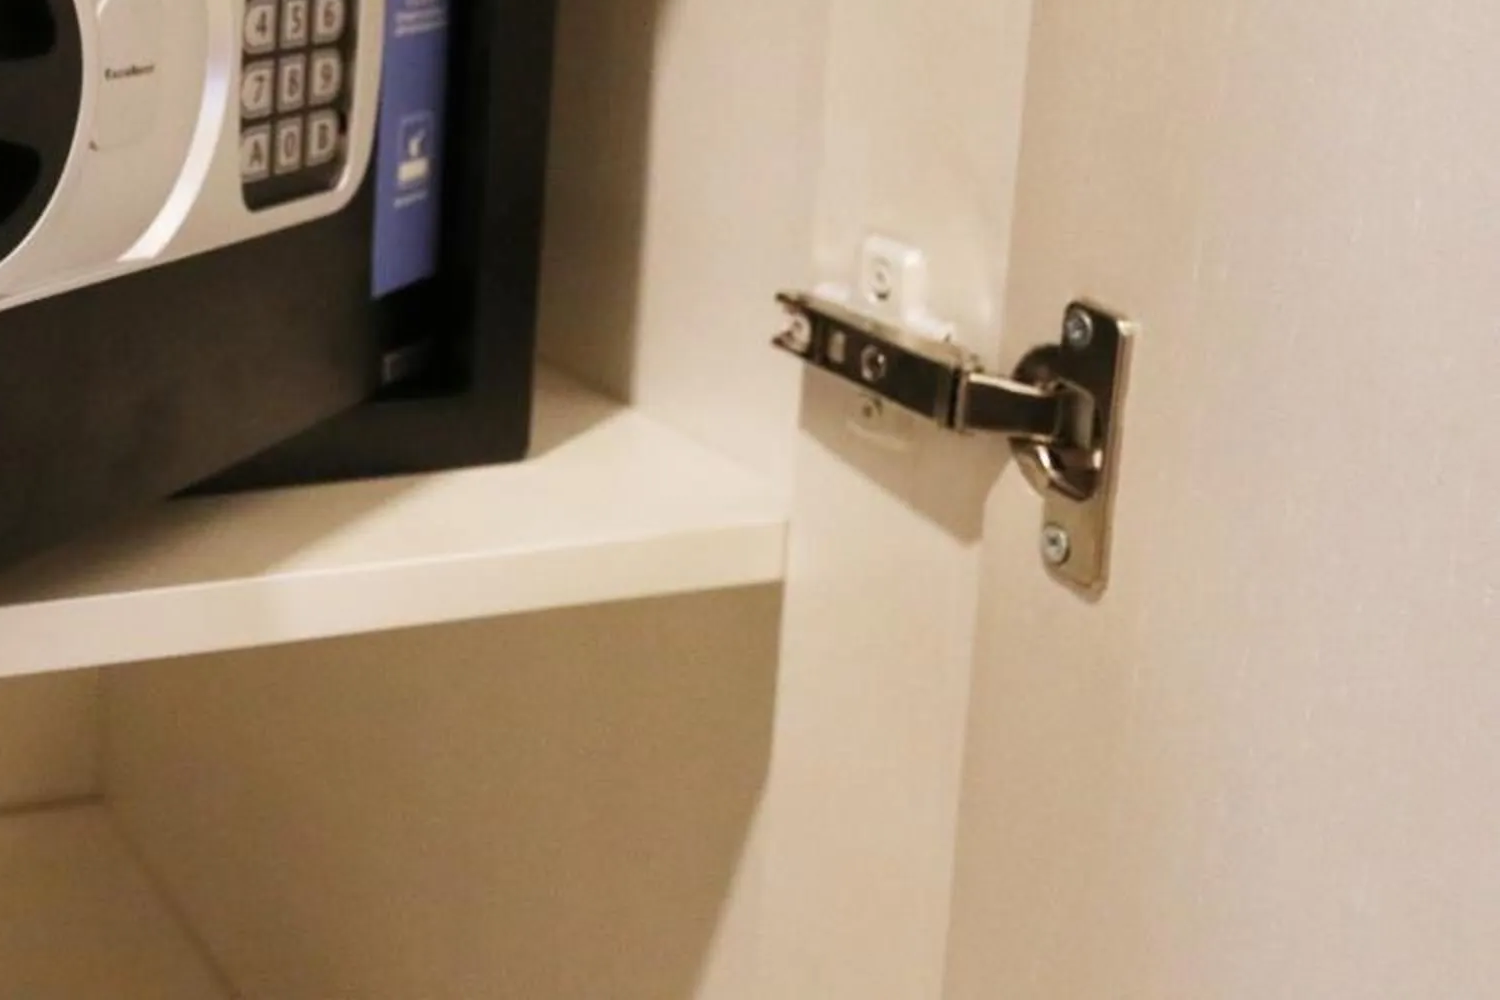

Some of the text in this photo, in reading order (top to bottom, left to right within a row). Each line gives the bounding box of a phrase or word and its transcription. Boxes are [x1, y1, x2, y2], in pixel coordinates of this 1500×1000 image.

[255, 0, 336, 36] 4 5 6
[253, 62, 334, 103] 7 8 9
[248, 123, 330, 166] A 0 B
